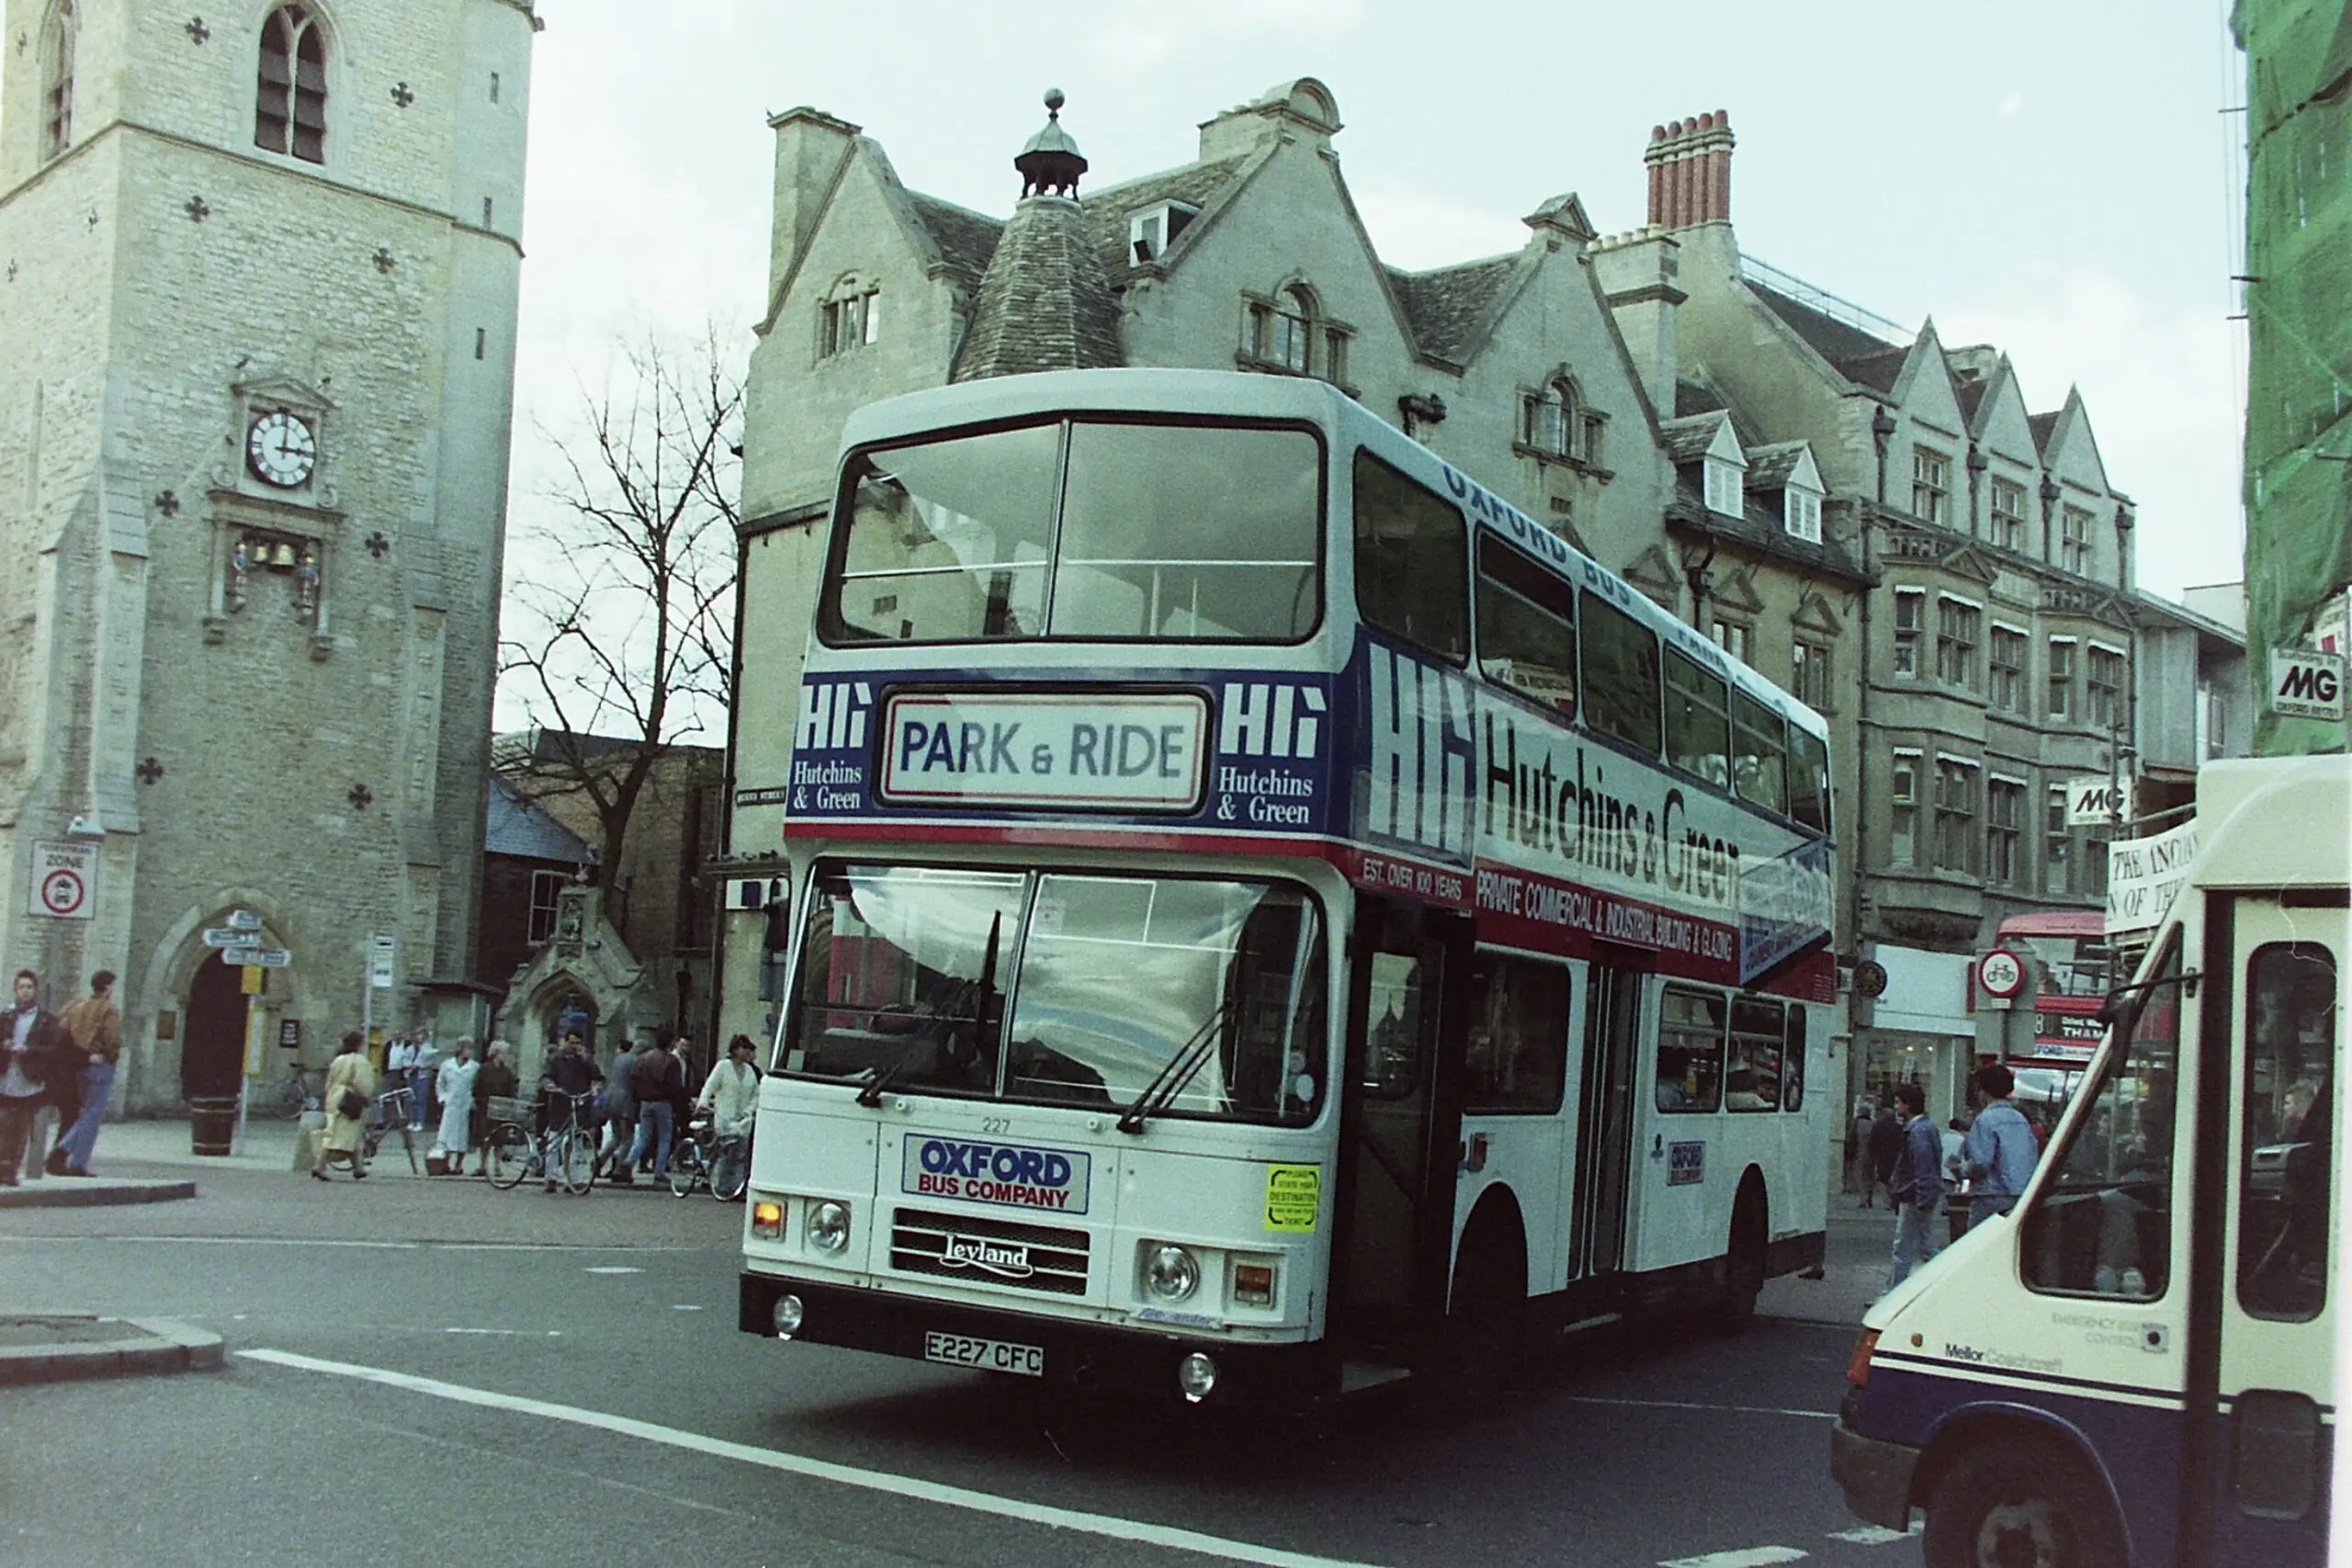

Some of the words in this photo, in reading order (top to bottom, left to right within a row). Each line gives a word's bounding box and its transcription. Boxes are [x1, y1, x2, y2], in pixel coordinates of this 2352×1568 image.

[2278, 665, 2338, 702] MG
[899, 721, 1022, 773] PARK
[1031, 743, 1054, 775] &
[1069, 723, 1185, 778] RIDE
[794, 760, 863, 785] Hutchins
[1218, 766, 1314, 796] Hutchins
[793, 785, 808, 810] &
[817, 787, 861, 810] Green
[1216, 794, 1237, 820] &
[1249, 795, 1310, 824] Green
[1485, 708, 1638, 878] Hutchins
[1643, 811, 1657, 884] &
[1663, 787, 1740, 907] Green
[46, 853, 85, 868] ZONE
[2114, 849, 2143, 881] THE
[1363, 858, 1385, 883] EST.
[1387, 863, 1413, 890] OVER
[1417, 871, 1432, 895] 100
[1435, 874, 1463, 901] YEARS
[1476, 869, 1522, 916] PRIVATE
[1606, 901, 1656, 945] INDUSTRIAL
[1656, 915, 1691, 953] BUILDING
[1702, 926, 1733, 962] GLAZING
[982, 1117, 1011, 1134] 227
[921, 1139, 1071, 1188] OXFORD
[919, 1173, 959, 1196] BUS
[965, 1179, 1070, 1209] COMPANY
[941, 1232, 1031, 1272] Leyland
[926, 1334, 989, 1364] E227
[994, 1344, 1042, 1372] CFC
[1945, 1342, 1984, 1362] Mellor
